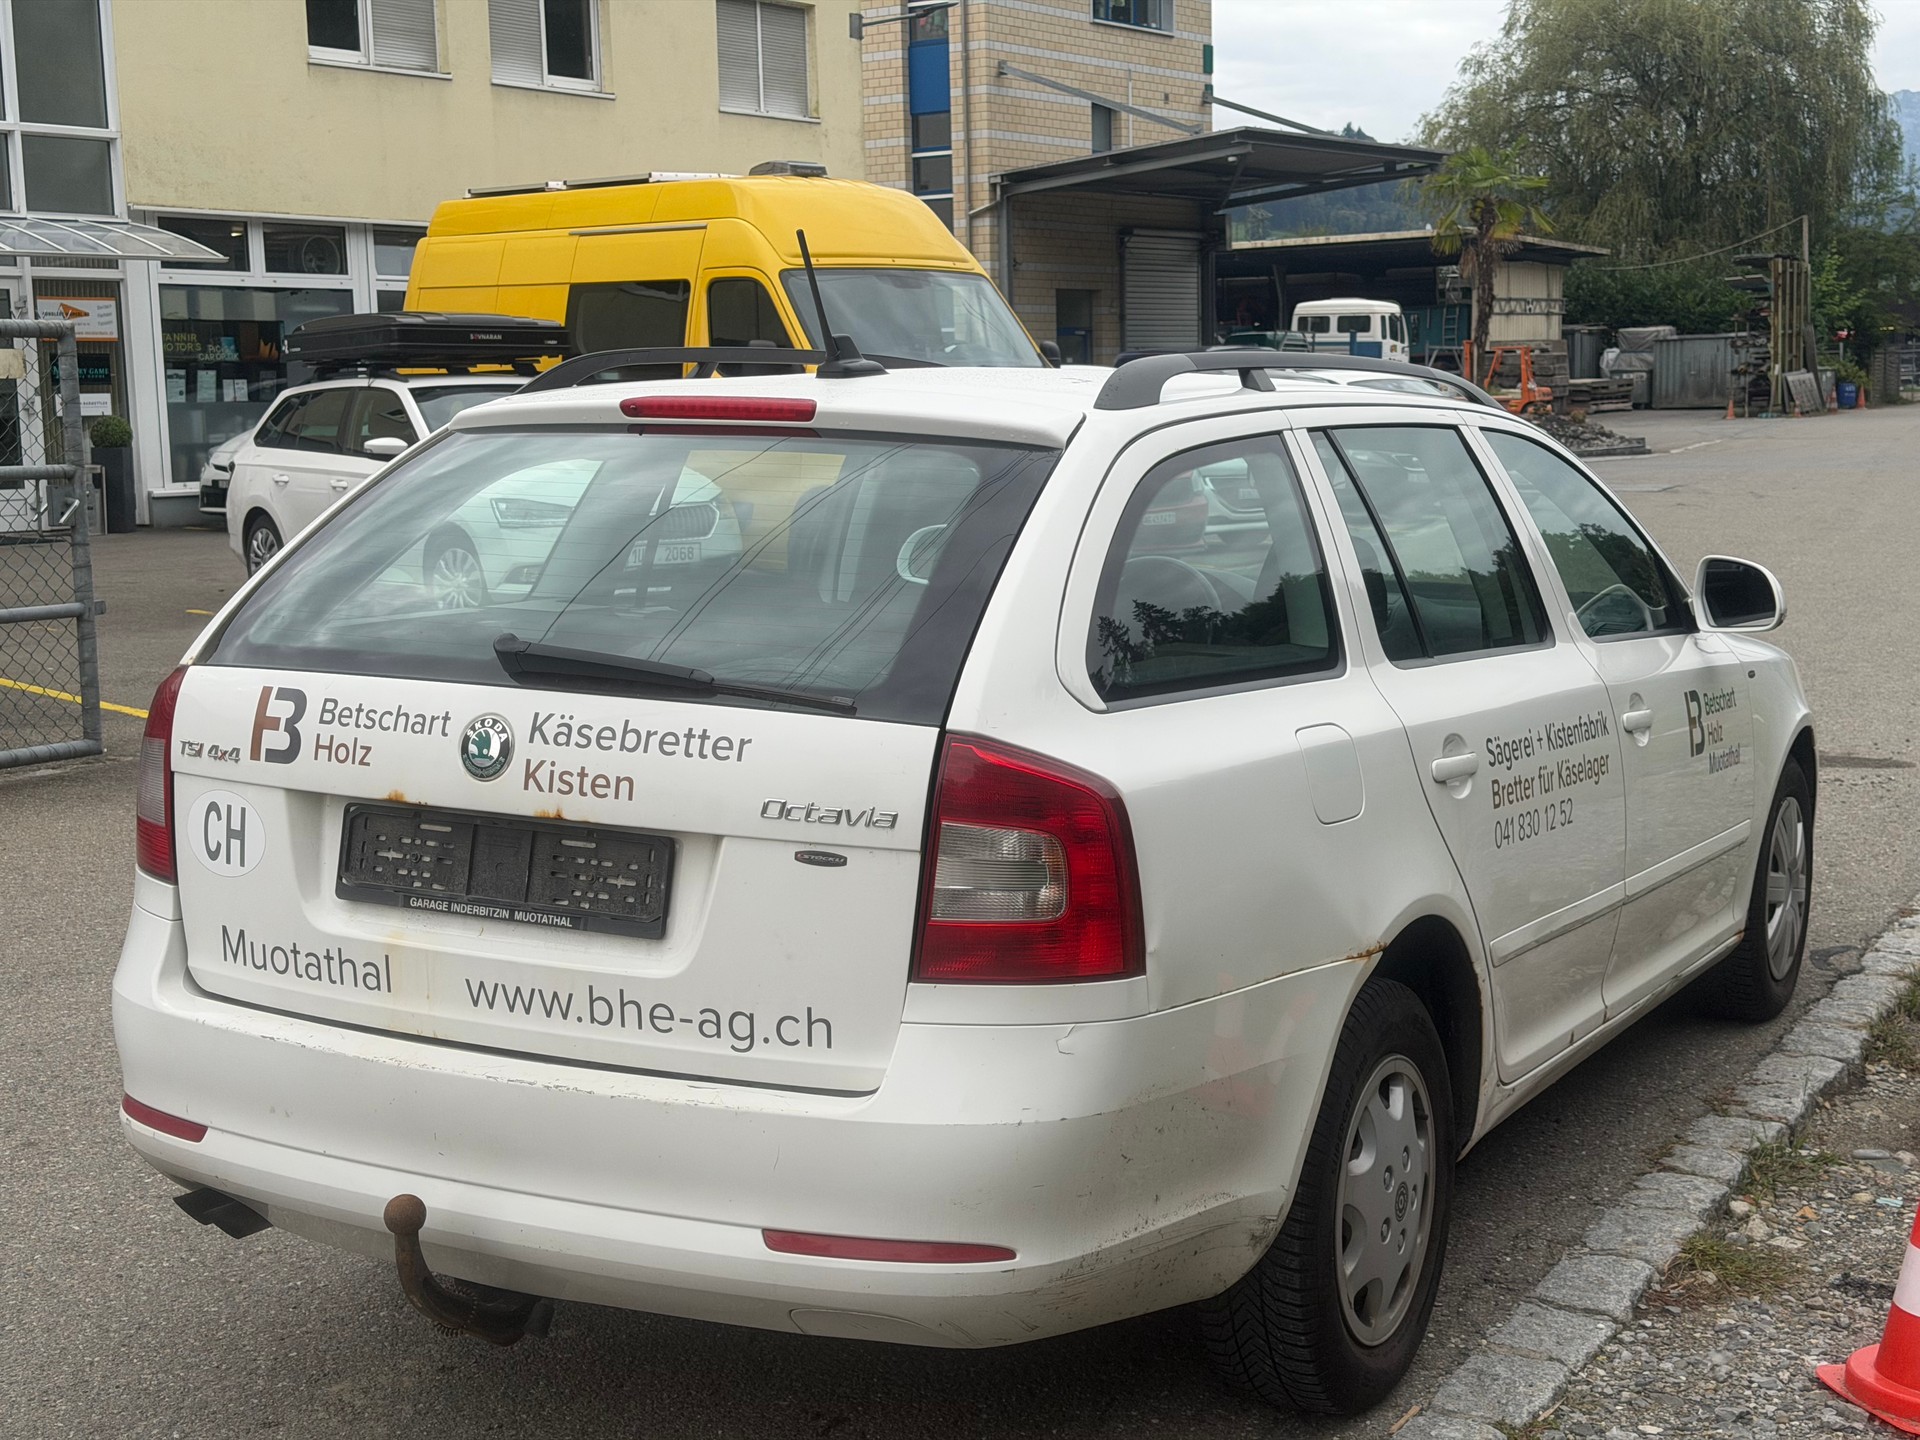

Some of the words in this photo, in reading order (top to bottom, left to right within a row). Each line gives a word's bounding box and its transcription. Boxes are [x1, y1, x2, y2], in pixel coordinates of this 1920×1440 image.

[665, 546, 694, 562] 2068
[318, 697, 452, 737] Betschart
[1703, 687, 1737, 716] Betschart
[180, 740, 204, 758] TSI
[207, 744, 241, 764] 4x4
[313, 733, 373, 767] Holz
[528, 711, 753, 763] Käsebretter
[1485, 730, 1536, 771] Sägerei
[1544, 711, 1610, 752] Kistenfabrik
[1707, 720, 1724, 746] Holz
[1709, 743, 1741, 775] Muotathal
[523, 758, 635, 802] Kisten
[1491, 768, 1536, 810] Bretter
[1538, 763, 1555, 795] für
[1556, 752, 1611, 788] Käselager
[203, 800, 247, 868] CH
[760, 798, 899, 830] Octavia
[1494, 816, 1515, 849] 041
[1518, 808, 1540, 842] 830
[1544, 803, 1557, 832] 12
[1560, 797, 1574, 826] 52
[410, 897, 449, 911] GARAGE
[450, 902, 510, 919] INDERBITZIN
[514, 911, 573, 927] MUOTATHAL
[221, 924, 392, 993] Muotathal
[465, 977, 833, 1054] www.bhe-ag.ch
